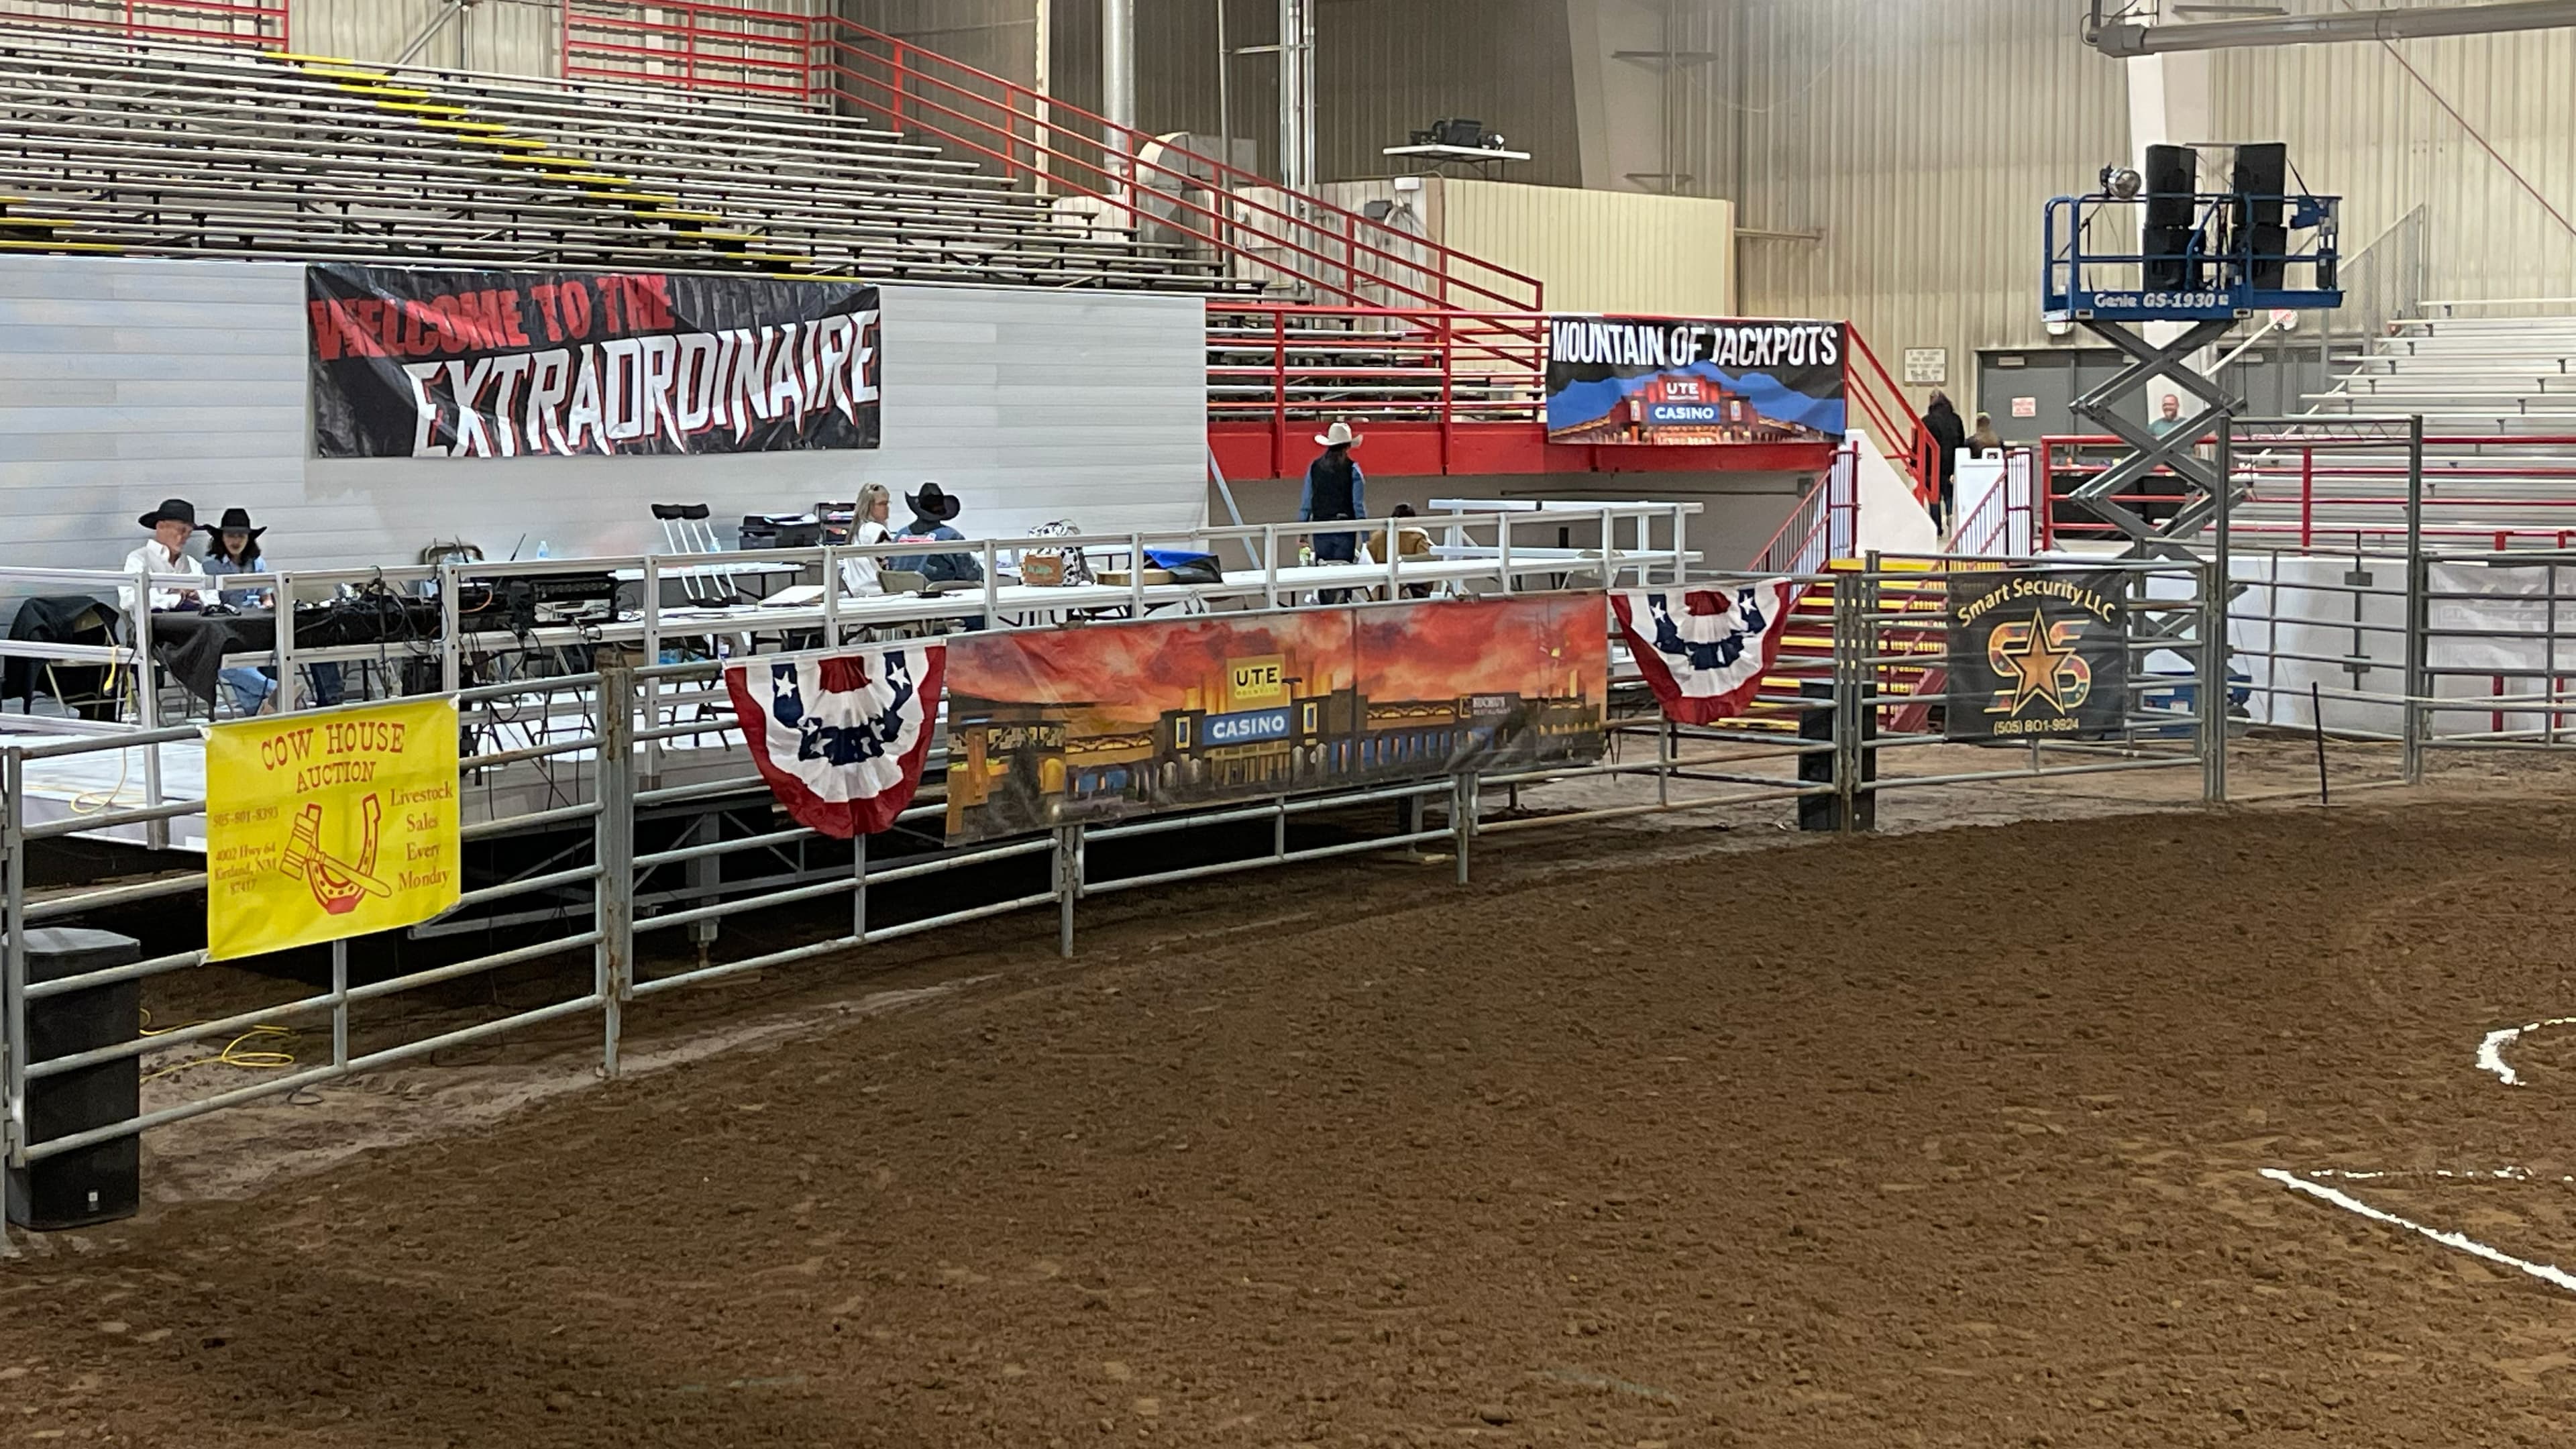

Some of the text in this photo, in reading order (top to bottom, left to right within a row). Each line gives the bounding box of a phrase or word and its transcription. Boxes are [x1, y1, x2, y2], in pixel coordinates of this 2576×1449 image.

[2094, 292, 2215, 308] Genie GS-1930
[310, 289, 531, 360] WELCOME
[531, 280, 592, 342] TO
[596, 274, 675, 333] THE
[1552, 321, 1837, 366] MOUNTAIN OF JACKPOTS
[402, 309, 880, 458] EXTRAORDINAIRE
[1666, 382, 1699, 394] UTE
[1654, 407, 1714, 419] CASINO
[1957, 578, 2116, 628] Smart Security LLC
[1236, 667, 1278, 686] UTE
[1212, 715, 1285, 739] CASINO
[1994, 720, 2023, 736] (505)
[260, 722, 406, 771] COW HOUSE
[297, 761, 376, 794] AUCTION
[390, 780, 453, 807] Livestock
[407, 812, 439, 833] Sales
[407, 841, 441, 862] Every
[398, 867, 450, 892] Monday
